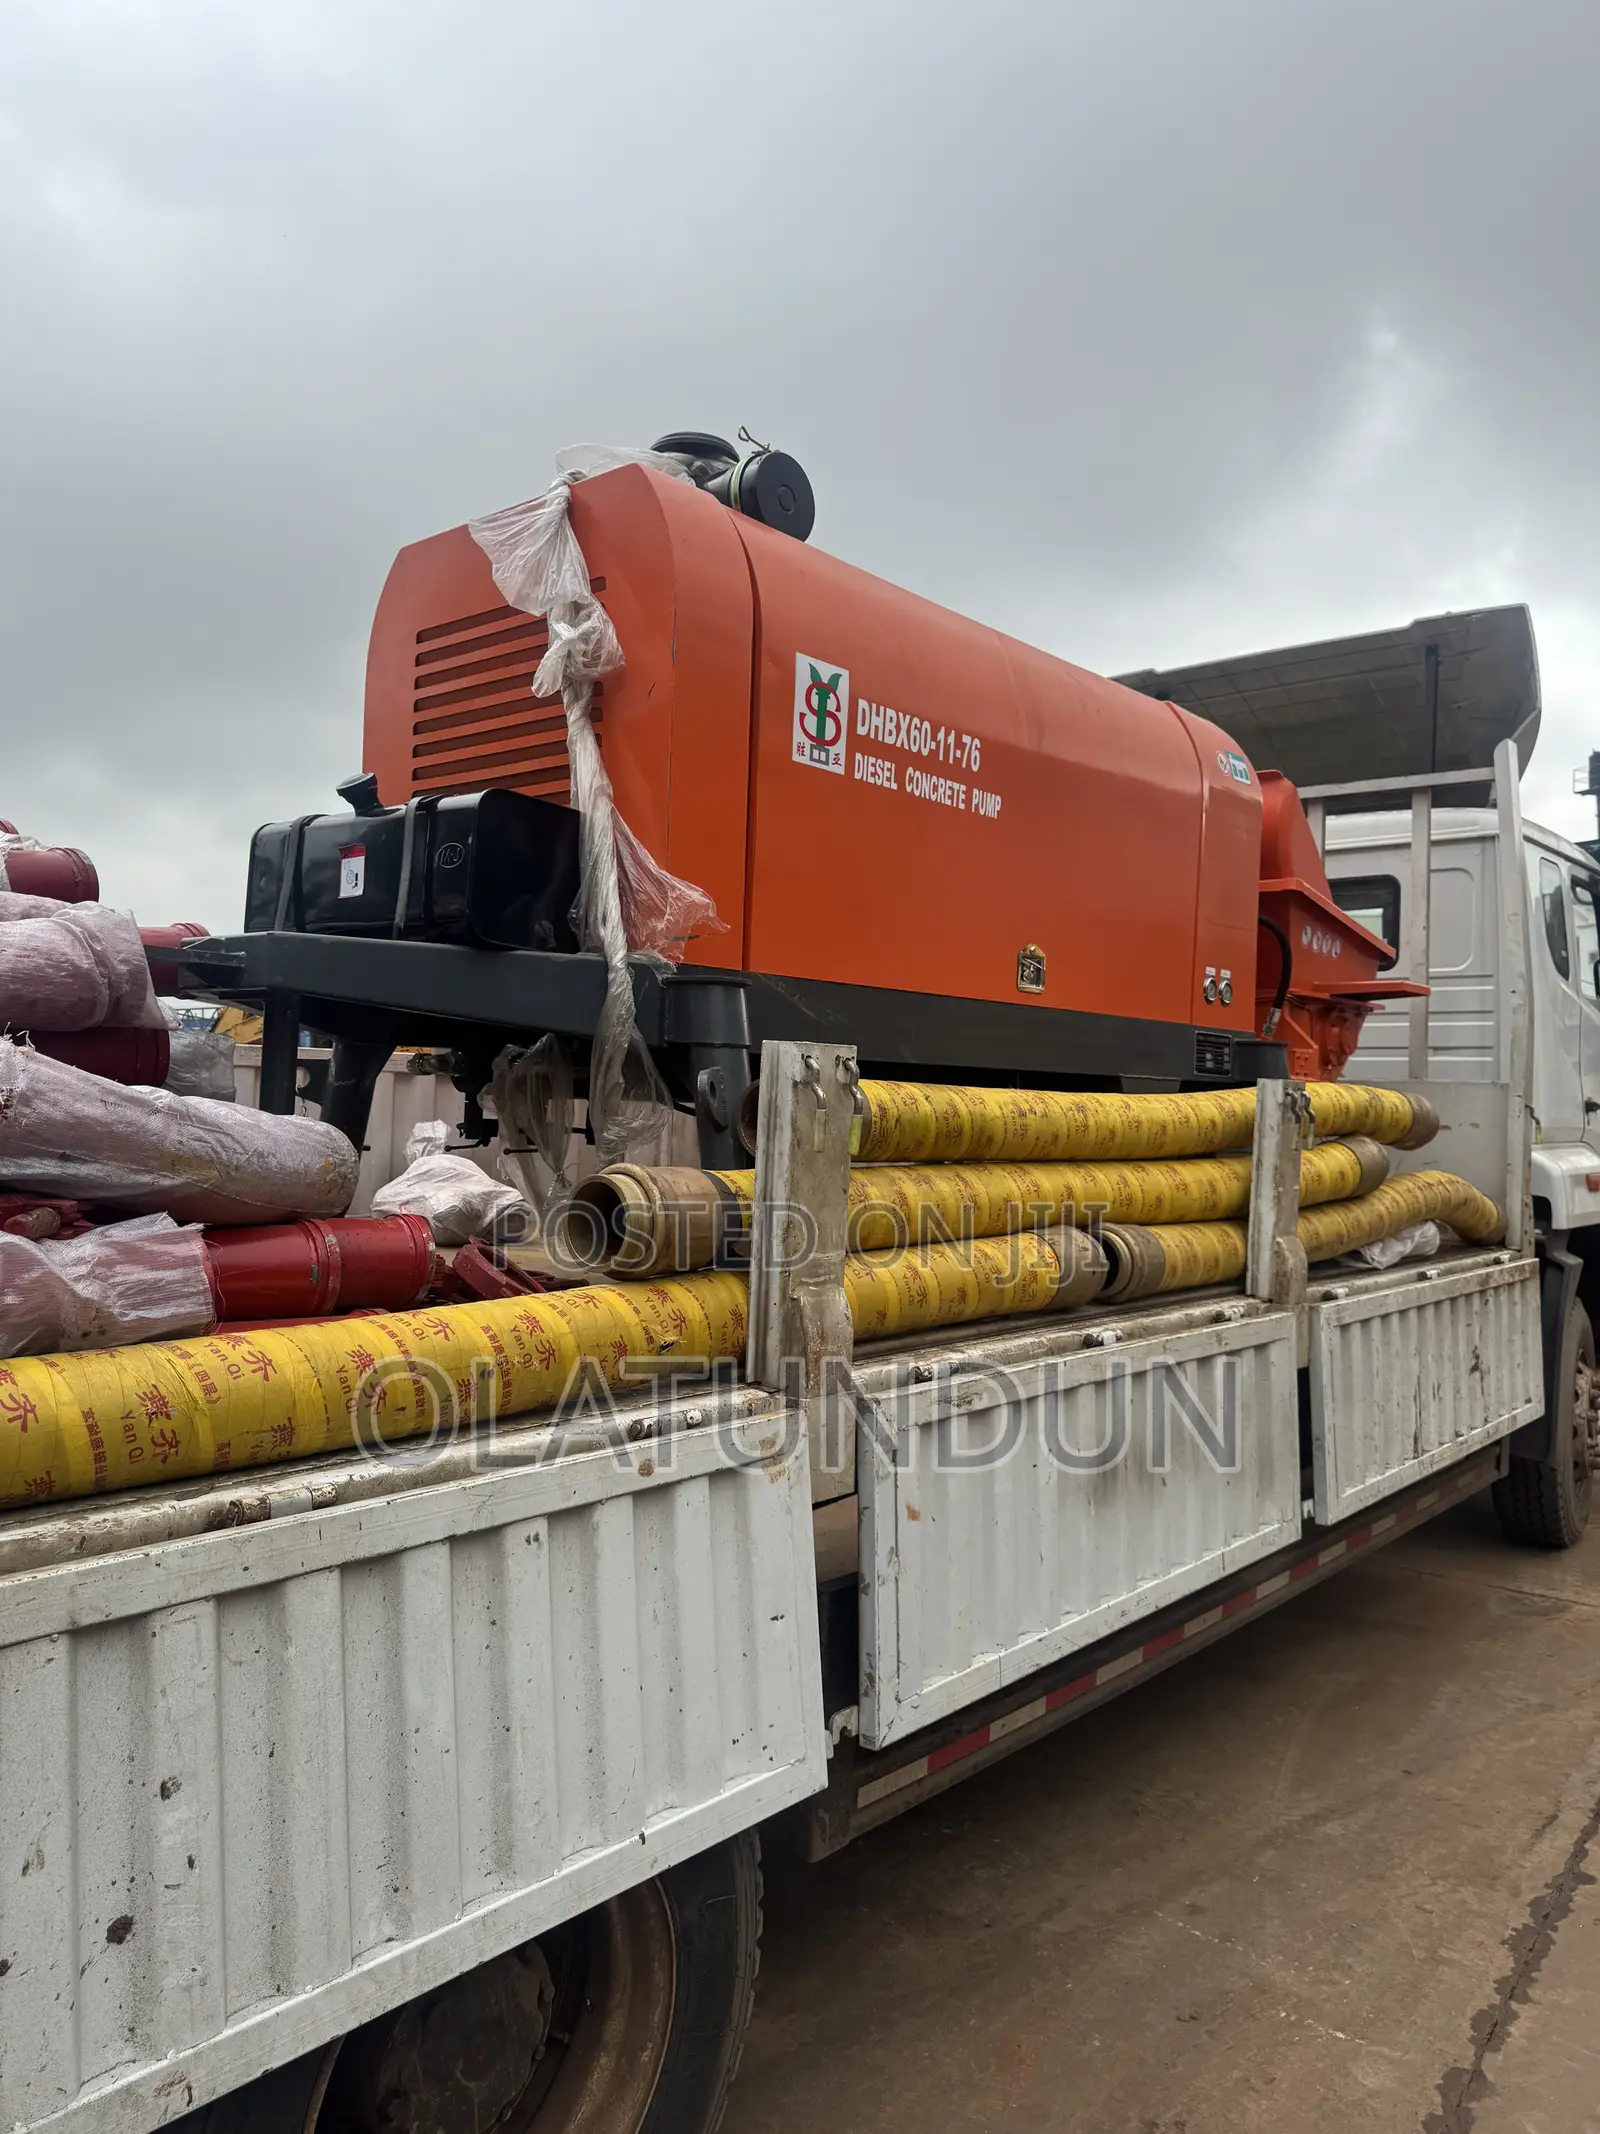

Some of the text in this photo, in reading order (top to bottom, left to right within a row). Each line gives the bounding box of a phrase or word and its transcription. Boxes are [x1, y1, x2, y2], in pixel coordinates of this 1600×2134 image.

[856, 698, 981, 773] DHBX60-11-76
[854, 752, 1002, 819] DIESEL CONCRETE PUMP
